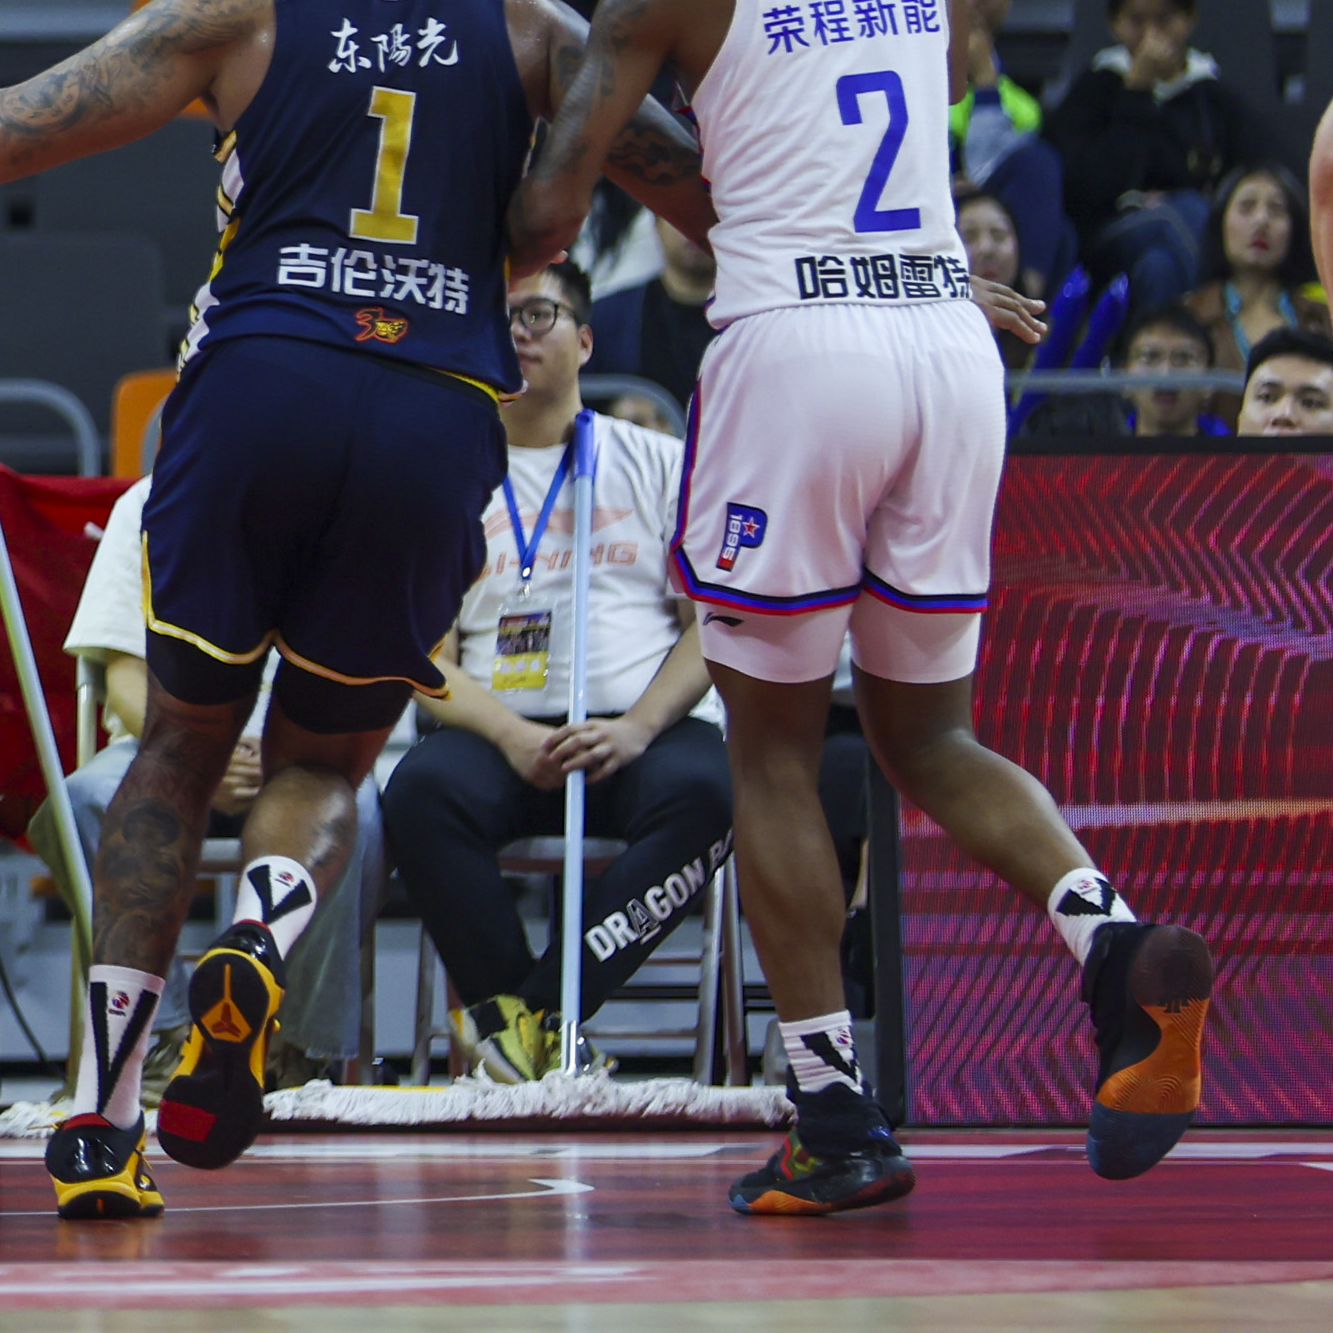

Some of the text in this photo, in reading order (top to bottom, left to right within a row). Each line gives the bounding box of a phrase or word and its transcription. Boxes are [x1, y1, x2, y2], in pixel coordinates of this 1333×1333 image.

[349, 85, 419, 245] 1
[836, 70, 921, 233] 2
[277, 243, 470, 314] 吉伦沃特
[794, 253, 971, 300] 哈姆雷特
[722, 514, 743, 561] 1895
[584, 857, 706, 963] DRAGON
